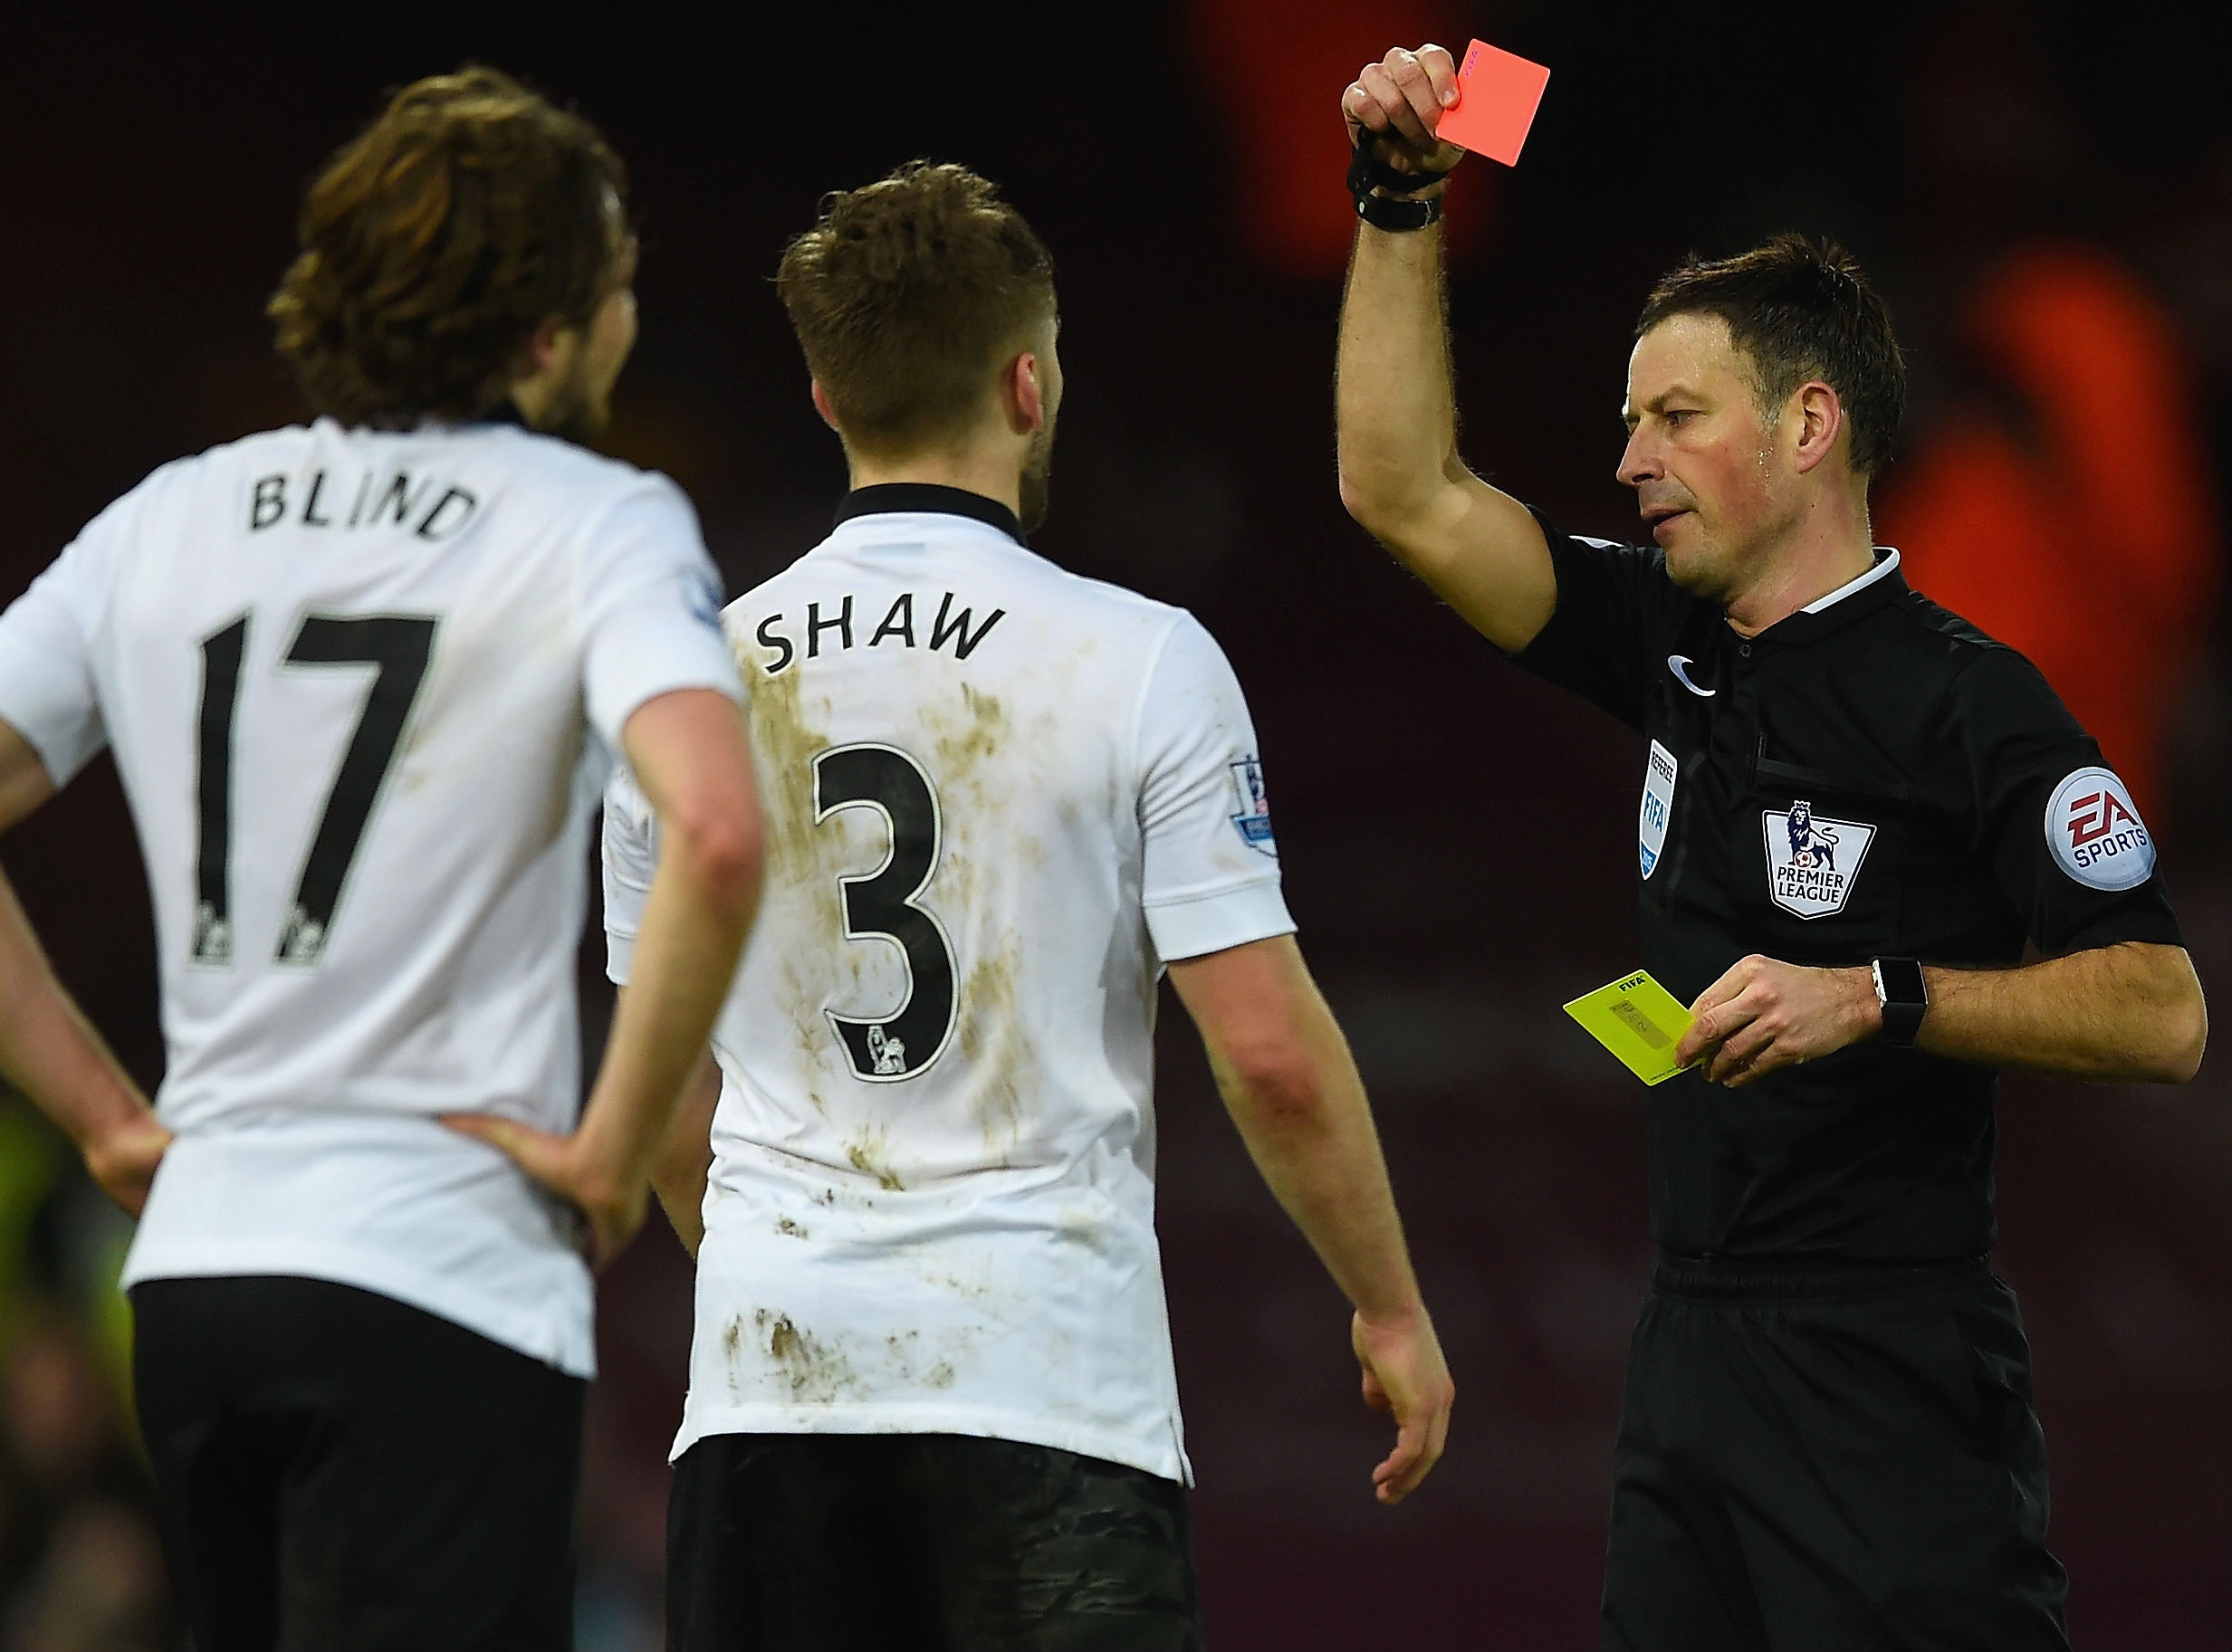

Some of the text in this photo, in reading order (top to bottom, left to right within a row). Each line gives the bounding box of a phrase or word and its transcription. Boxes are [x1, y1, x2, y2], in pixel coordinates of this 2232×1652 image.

[249, 470, 478, 541] BLIND
[757, 592, 1005, 673] SHAW
[189, 606, 444, 965] 17
[1643, 789, 1665, 833] FIFA
[2067, 790, 2140, 848] EA
[2074, 828, 2148, 868] SPORTS
[1777, 866, 1844, 889] PREMIER
[1778, 882, 1840, 903] LEAGUE
[812, 741, 961, 1083] 3
[1618, 976, 1646, 992] FIFA
